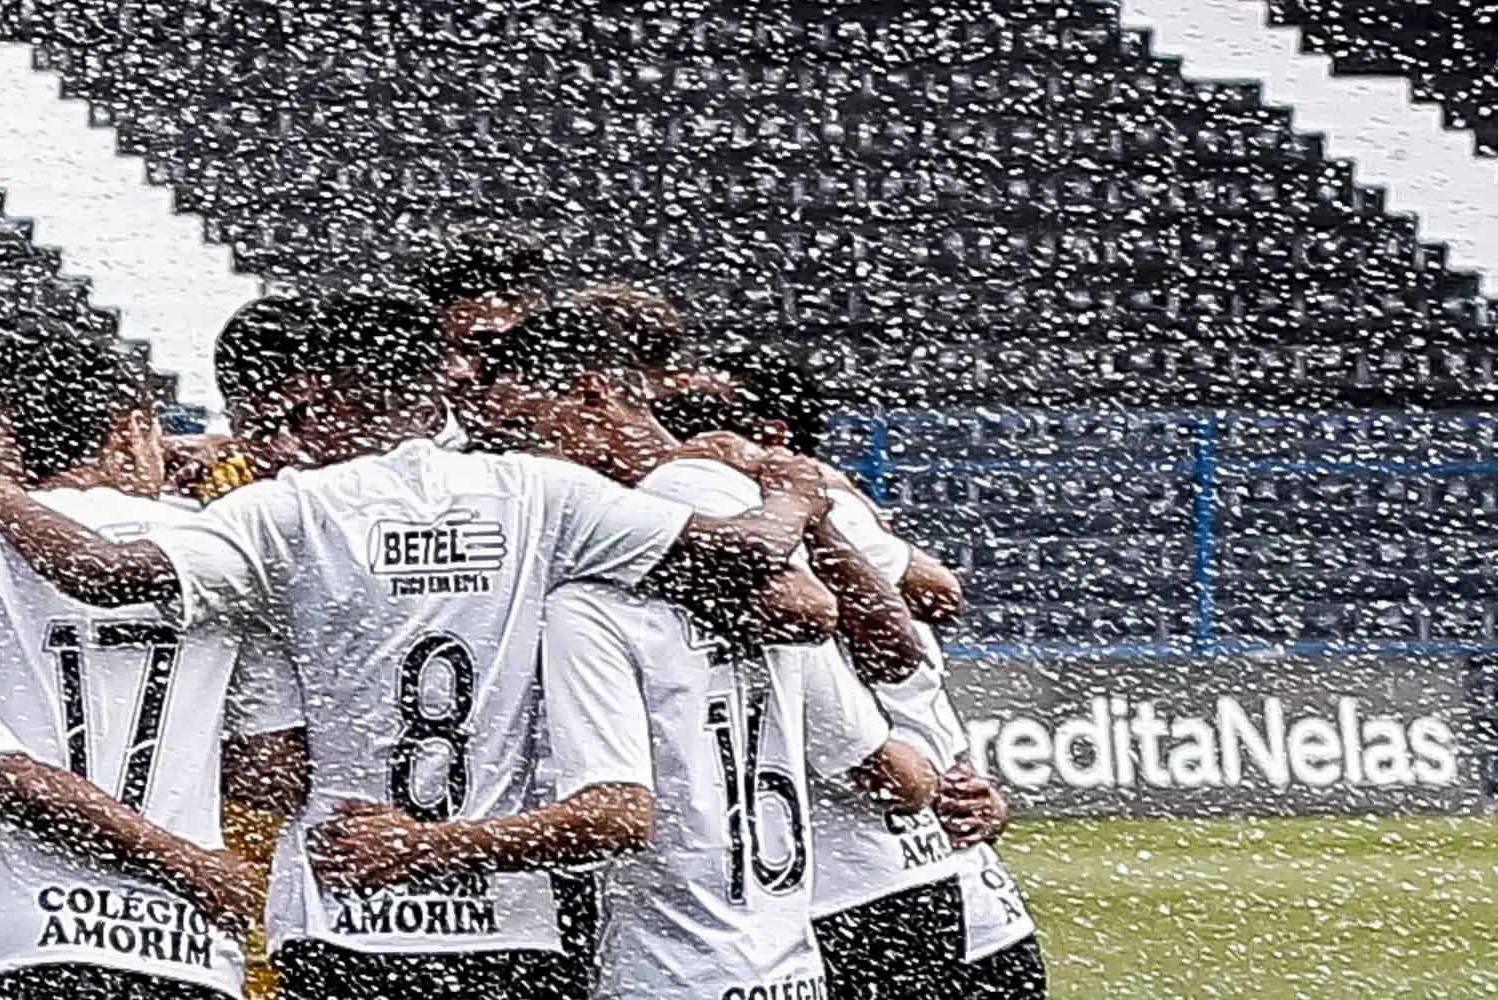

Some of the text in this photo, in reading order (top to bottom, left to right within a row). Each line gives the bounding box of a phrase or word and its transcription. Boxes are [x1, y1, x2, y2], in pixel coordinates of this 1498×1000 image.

[384, 528, 466, 565] BETEL
[46, 621, 179, 811] 17
[389, 632, 476, 821] 8
[37, 915, 213, 969] AMORIM
[332, 897, 500, 934] AMORIM
